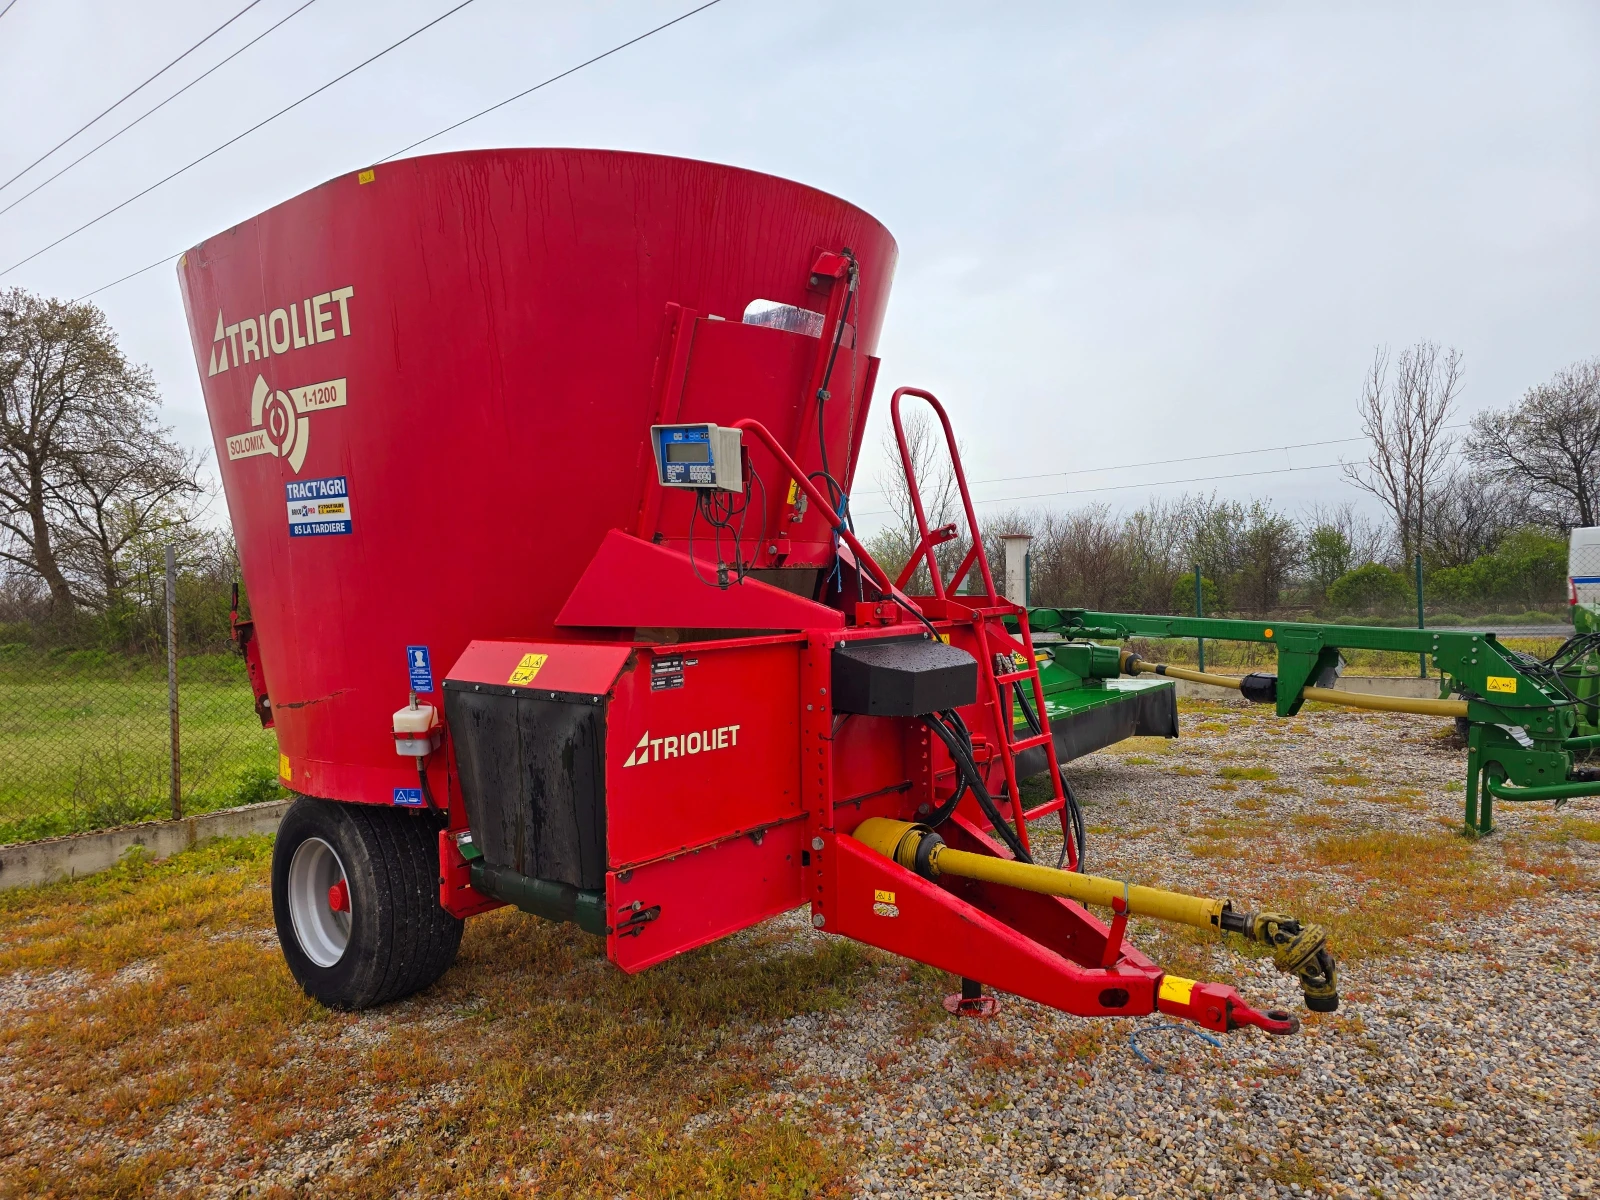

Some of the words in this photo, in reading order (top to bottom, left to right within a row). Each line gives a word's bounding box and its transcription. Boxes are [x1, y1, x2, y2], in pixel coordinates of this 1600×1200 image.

[225, 285, 354, 368] TRIOLIET
[302, 385, 337, 408] 1-1200
[230, 434, 265, 455] SOLOMIX
[287, 478, 346, 499] TRACT'AGRI
[294, 525, 303, 535] 85
[303, 524, 312, 534] LA
[312, 522, 346, 533] TARDIERE
[650, 724, 740, 762] TRIOLIET
